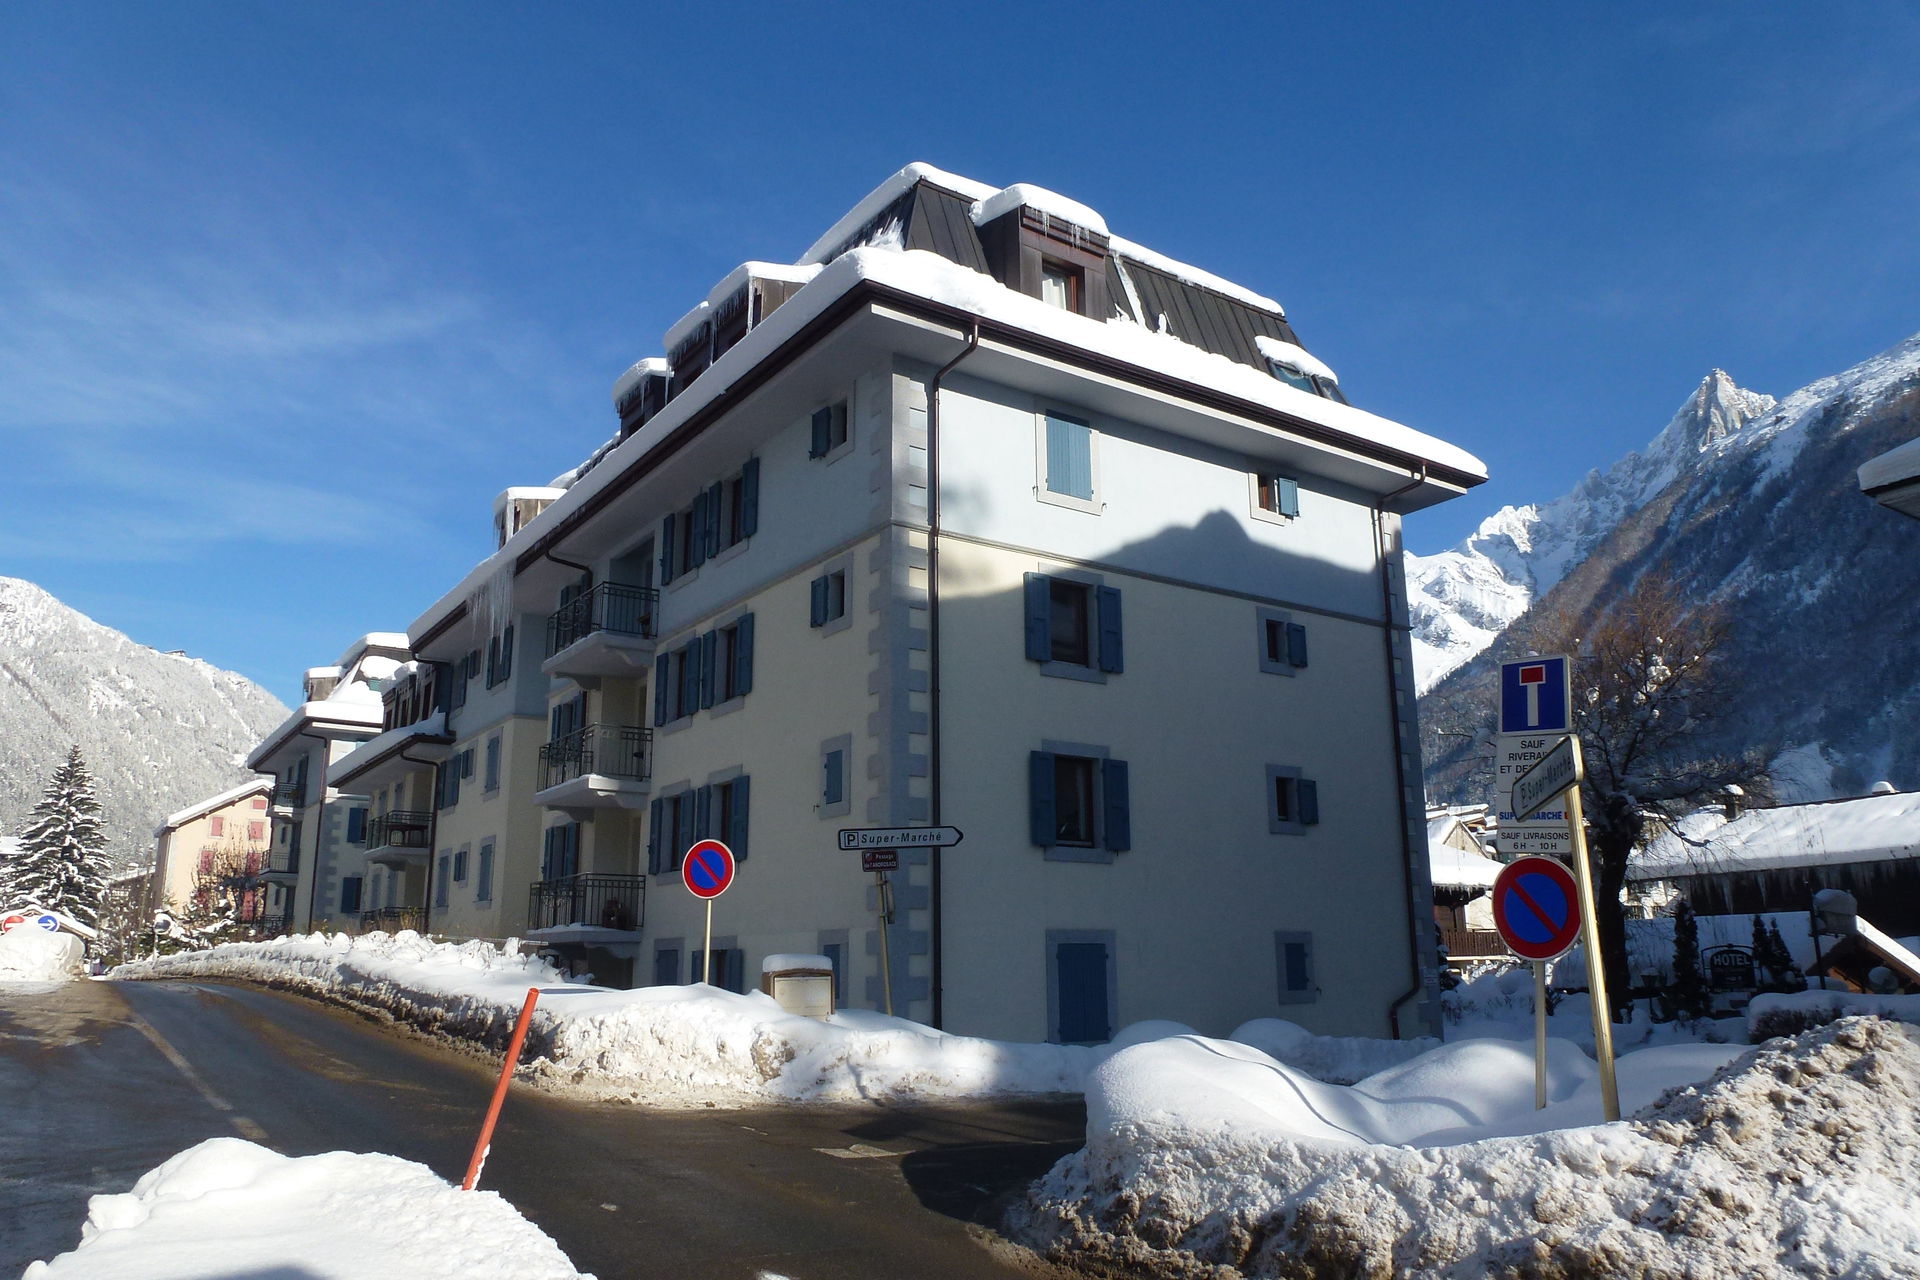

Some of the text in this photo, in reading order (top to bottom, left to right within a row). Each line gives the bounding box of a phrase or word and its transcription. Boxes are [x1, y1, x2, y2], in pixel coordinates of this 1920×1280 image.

[1520, 739, 1545, 749] SAUF
[1500, 764, 1512, 774] ET
[847, 831, 942, 846] P Super-Marché
[1501, 832, 1570, 841] SAUF LIVRAISONS
[1713, 953, 1751, 966] HOTEL
